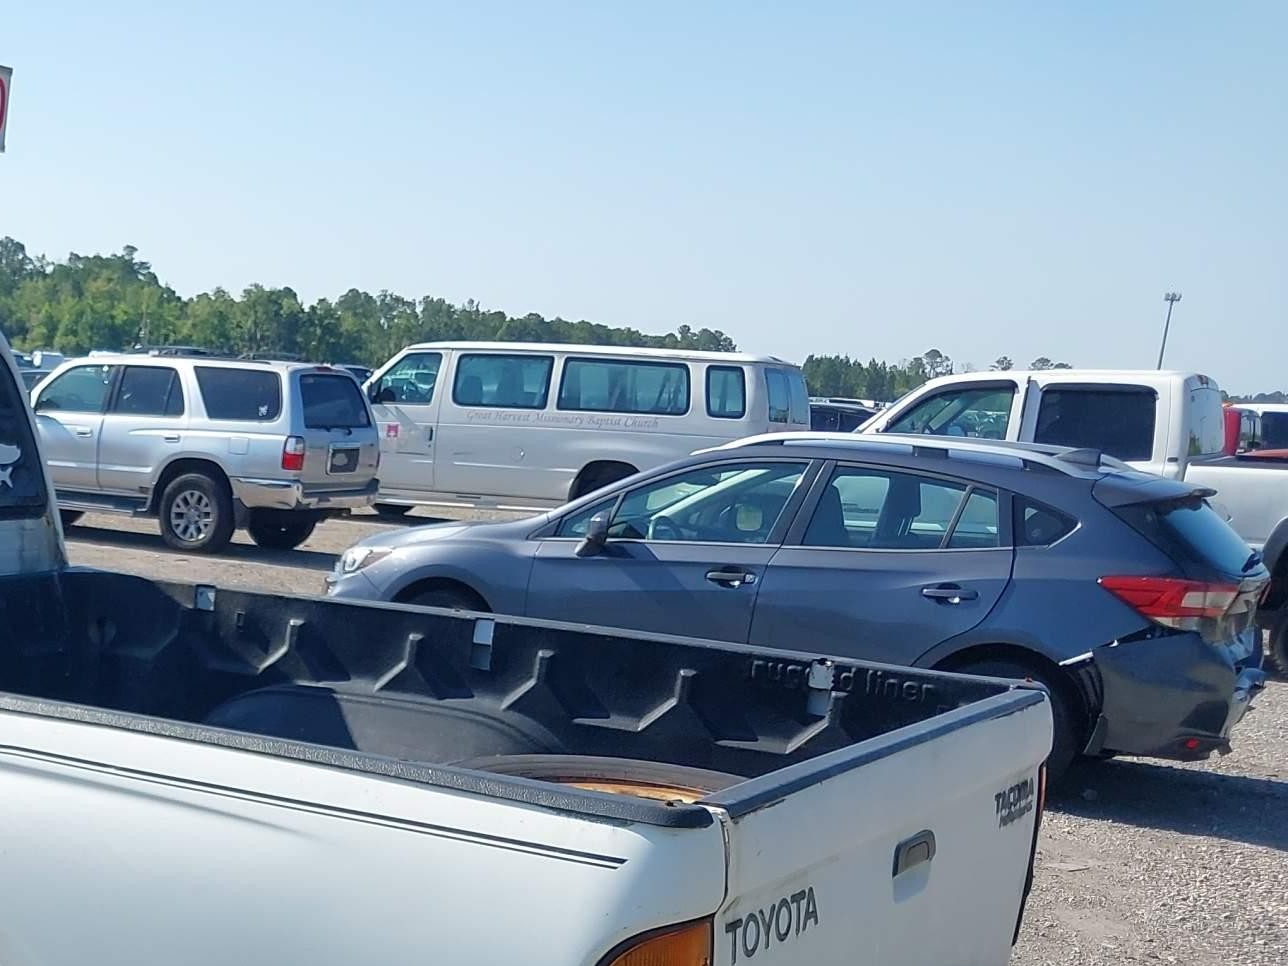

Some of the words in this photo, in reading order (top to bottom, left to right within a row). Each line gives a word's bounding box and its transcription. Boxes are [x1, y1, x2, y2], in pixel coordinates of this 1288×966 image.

[466, 410, 491, 421] Great
[493, 411, 530, 423] Harvest
[586, 415, 621, 428] Baptist
[624, 415, 660, 429] Church
[865, 669, 936, 702] liner
[725, 886, 819, 966] TOYOTA
